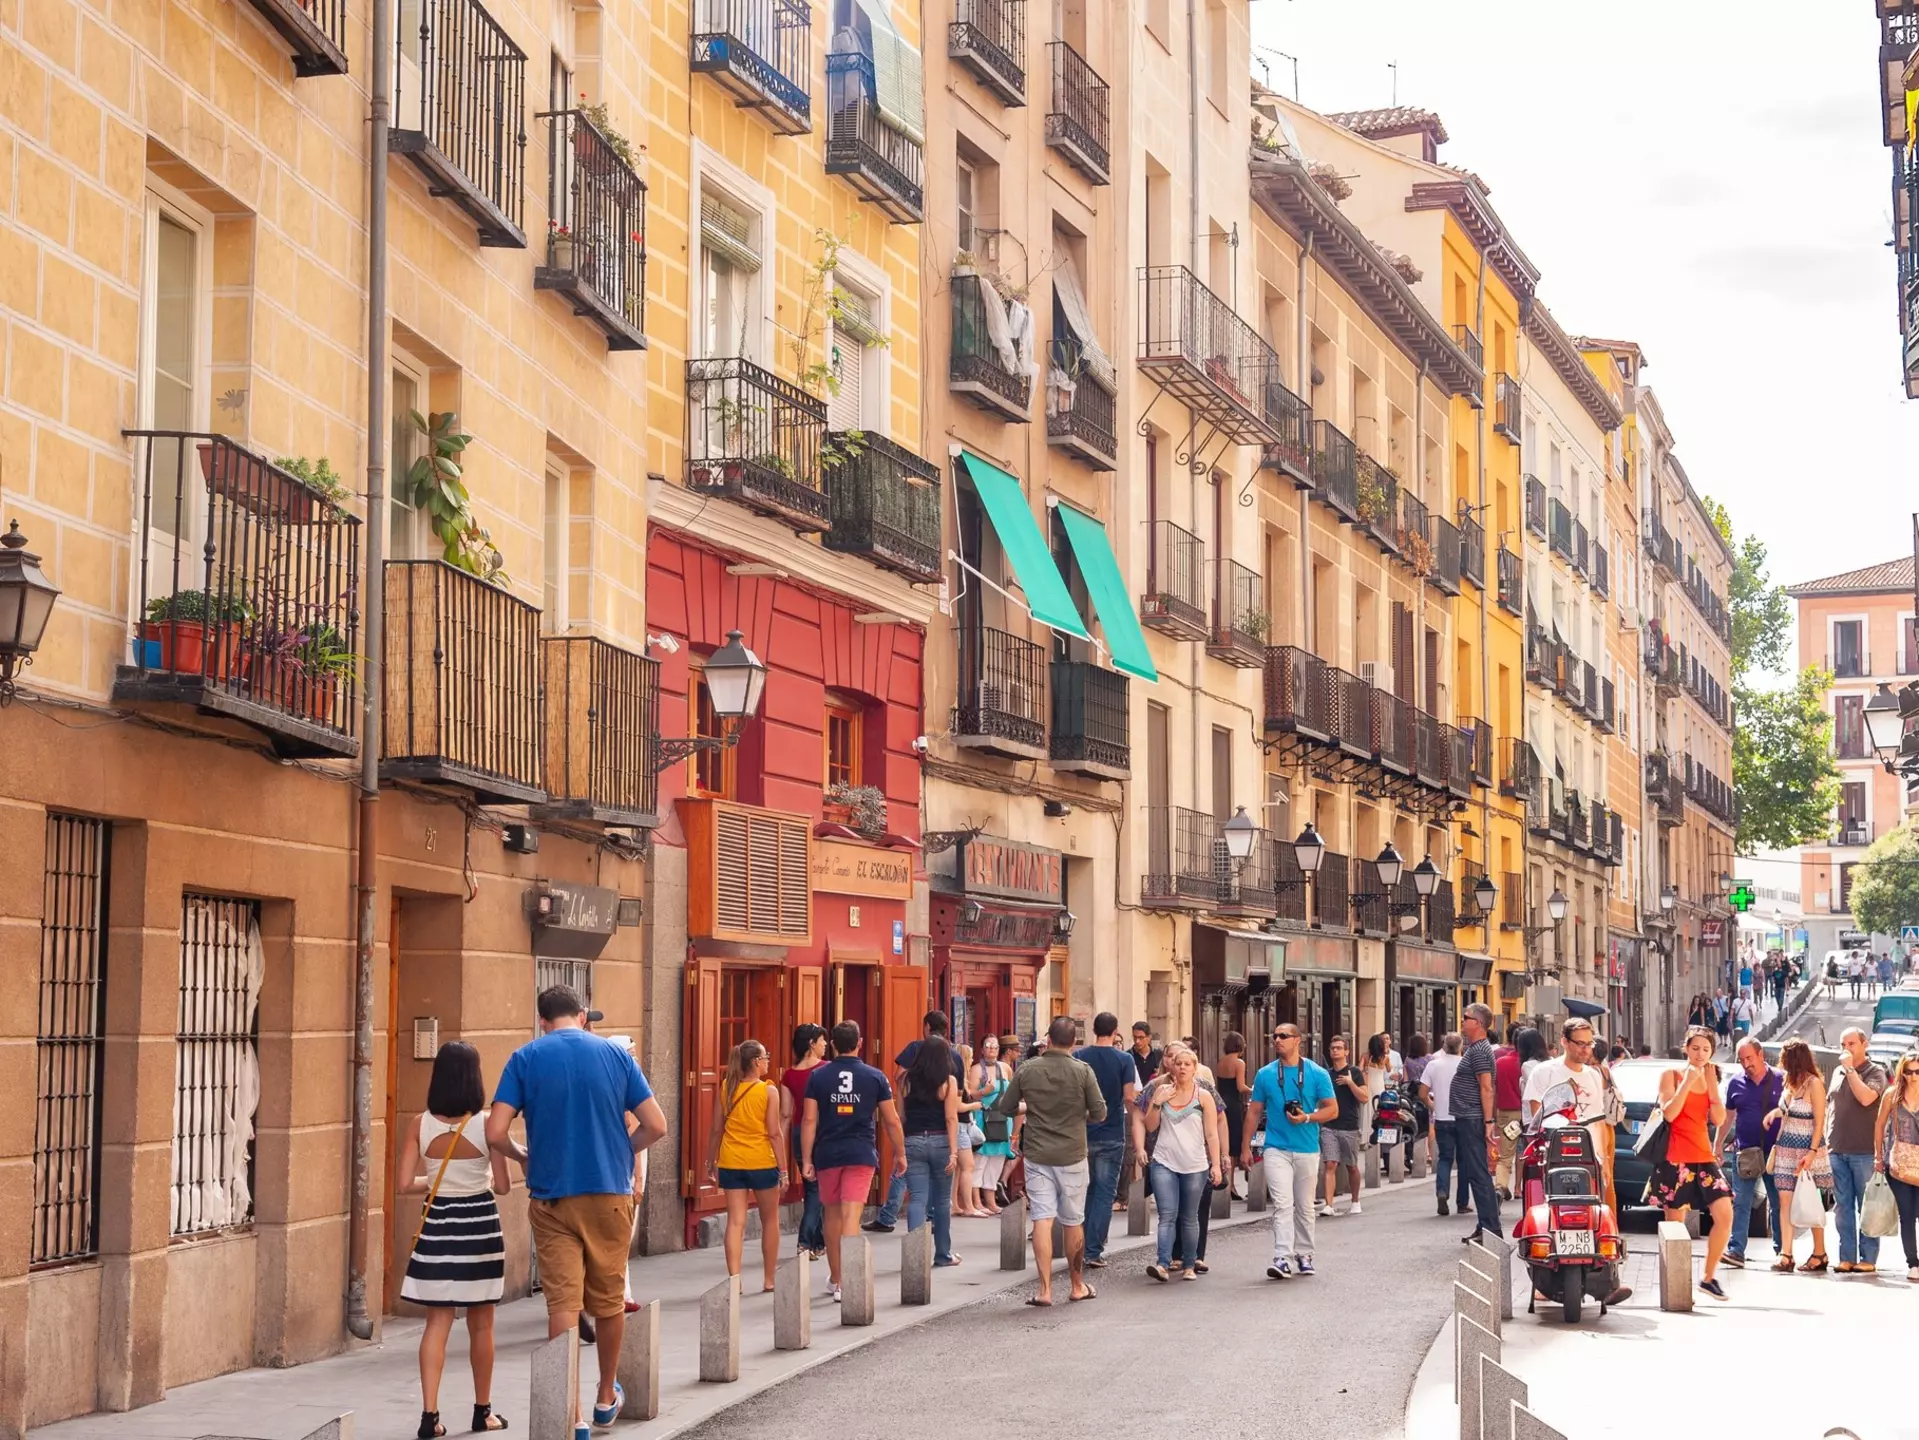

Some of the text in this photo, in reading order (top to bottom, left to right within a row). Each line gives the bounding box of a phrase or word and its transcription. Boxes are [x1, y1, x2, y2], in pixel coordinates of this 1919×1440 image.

[856, 859, 867, 879] EL
[838, 1070, 853, 1093] 3
[830, 1093, 861, 1103] SPAIN
[1561, 1244, 1591, 1254] 2250
